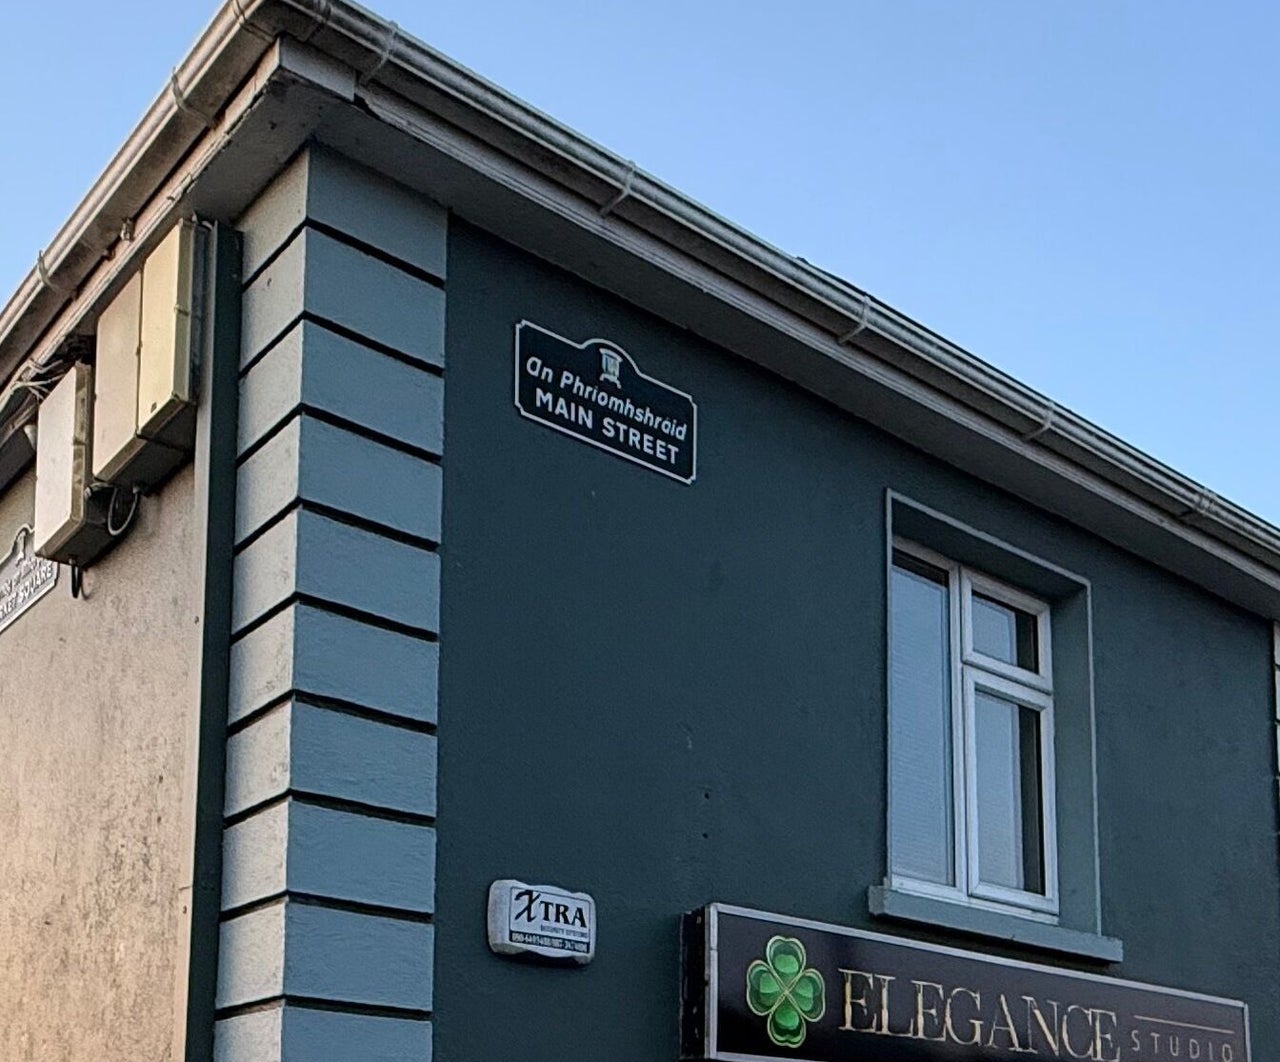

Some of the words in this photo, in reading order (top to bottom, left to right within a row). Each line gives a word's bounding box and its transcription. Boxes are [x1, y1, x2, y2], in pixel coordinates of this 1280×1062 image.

[535, 388, 594, 430] MAIN
[602, 417, 679, 465] STREET
[514, 889, 587, 928] XTRA
[838, 968, 1120, 1062] ELEGANCE
